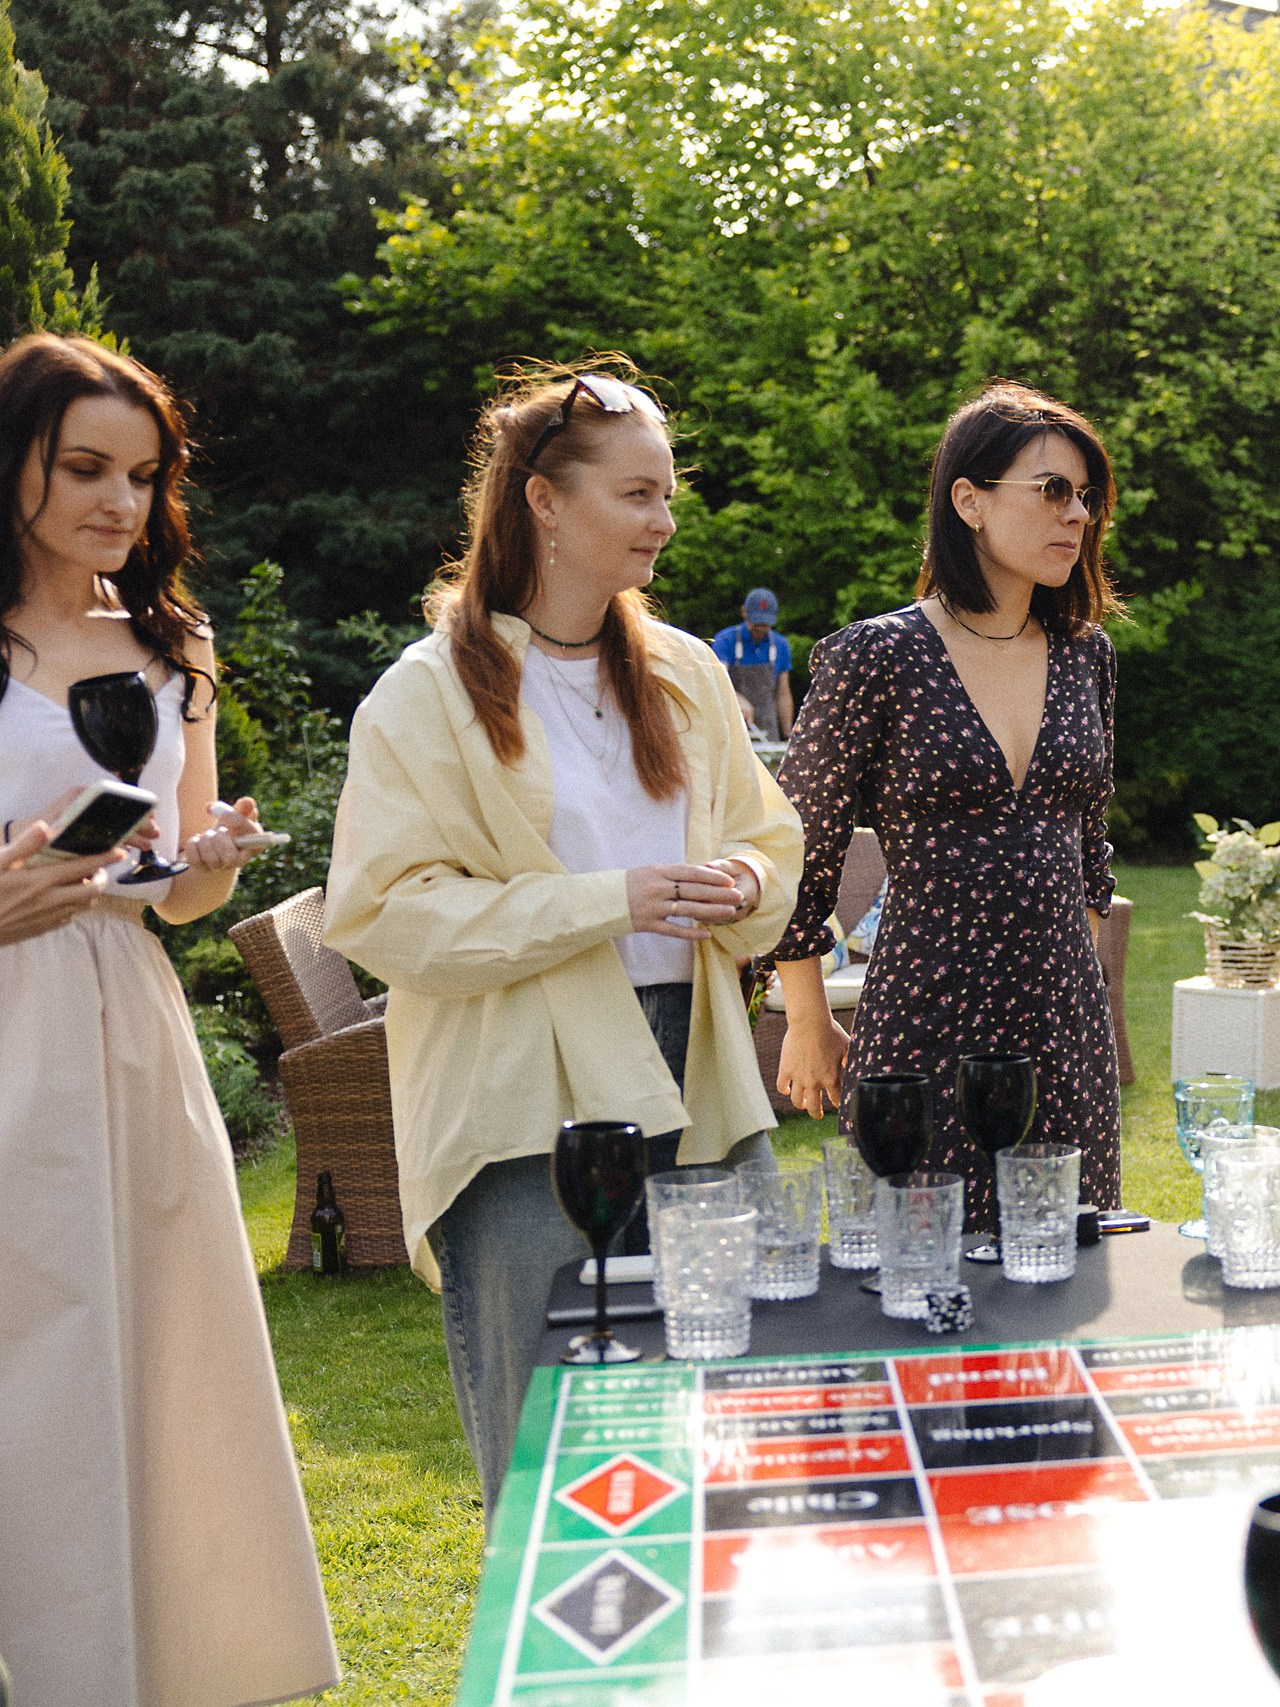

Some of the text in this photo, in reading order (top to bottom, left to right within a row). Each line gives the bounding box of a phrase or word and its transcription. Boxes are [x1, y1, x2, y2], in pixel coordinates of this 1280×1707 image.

[931, 1420, 1093, 1440] Sparkling
[723, 1449, 890, 1466] Argentin
[747, 1492, 879, 1513] Chile
